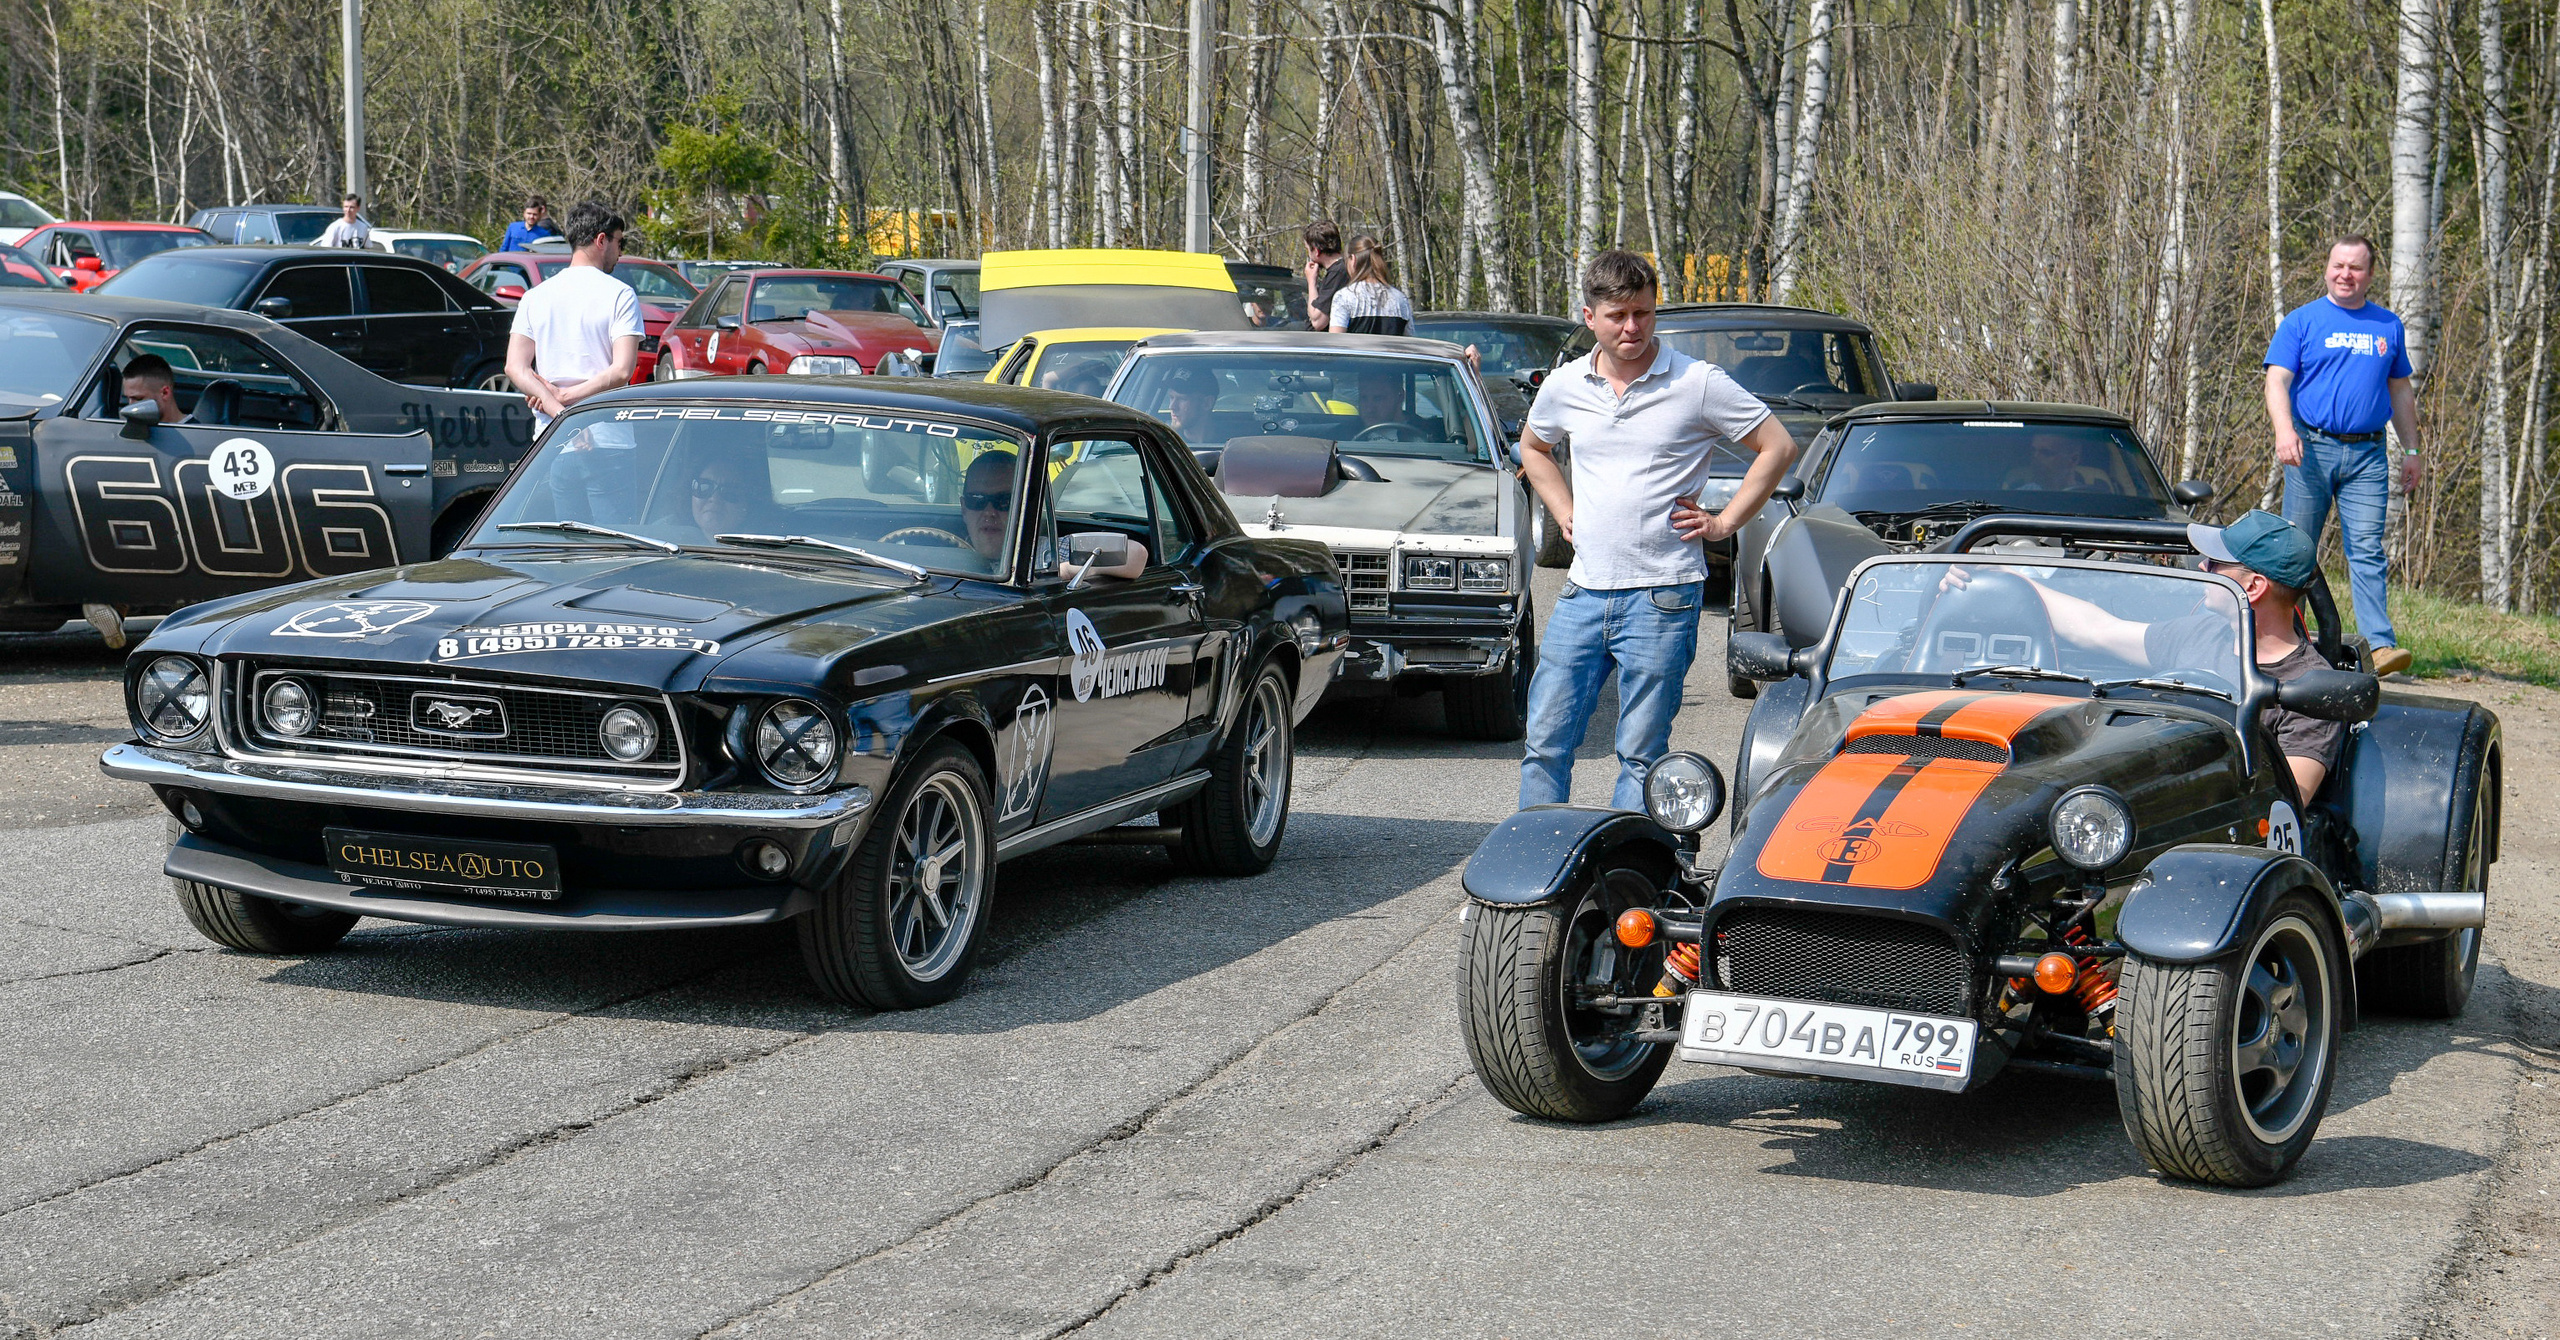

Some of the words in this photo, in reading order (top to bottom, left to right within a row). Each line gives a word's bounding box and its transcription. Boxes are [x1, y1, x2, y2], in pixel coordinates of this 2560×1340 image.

[2325, 337, 2370, 349] SAAB
[223, 449, 259, 477] 43
[65, 455, 399, 578] 606
[1860, 577, 1883, 606] 2
[438, 638, 459, 658] 8
[1075, 624, 1099, 668] 46
[1829, 839, 1872, 863] 13
[362, 876, 393, 887] ЧЕЛСИ
[463, 887, 474, 895] +7
[475, 888, 496, 897] (495)
[498, 889, 537, 899] 728-24-77
[1891, 1018, 1959, 1057] 799
[1900, 1053, 1935, 1068] RUS
